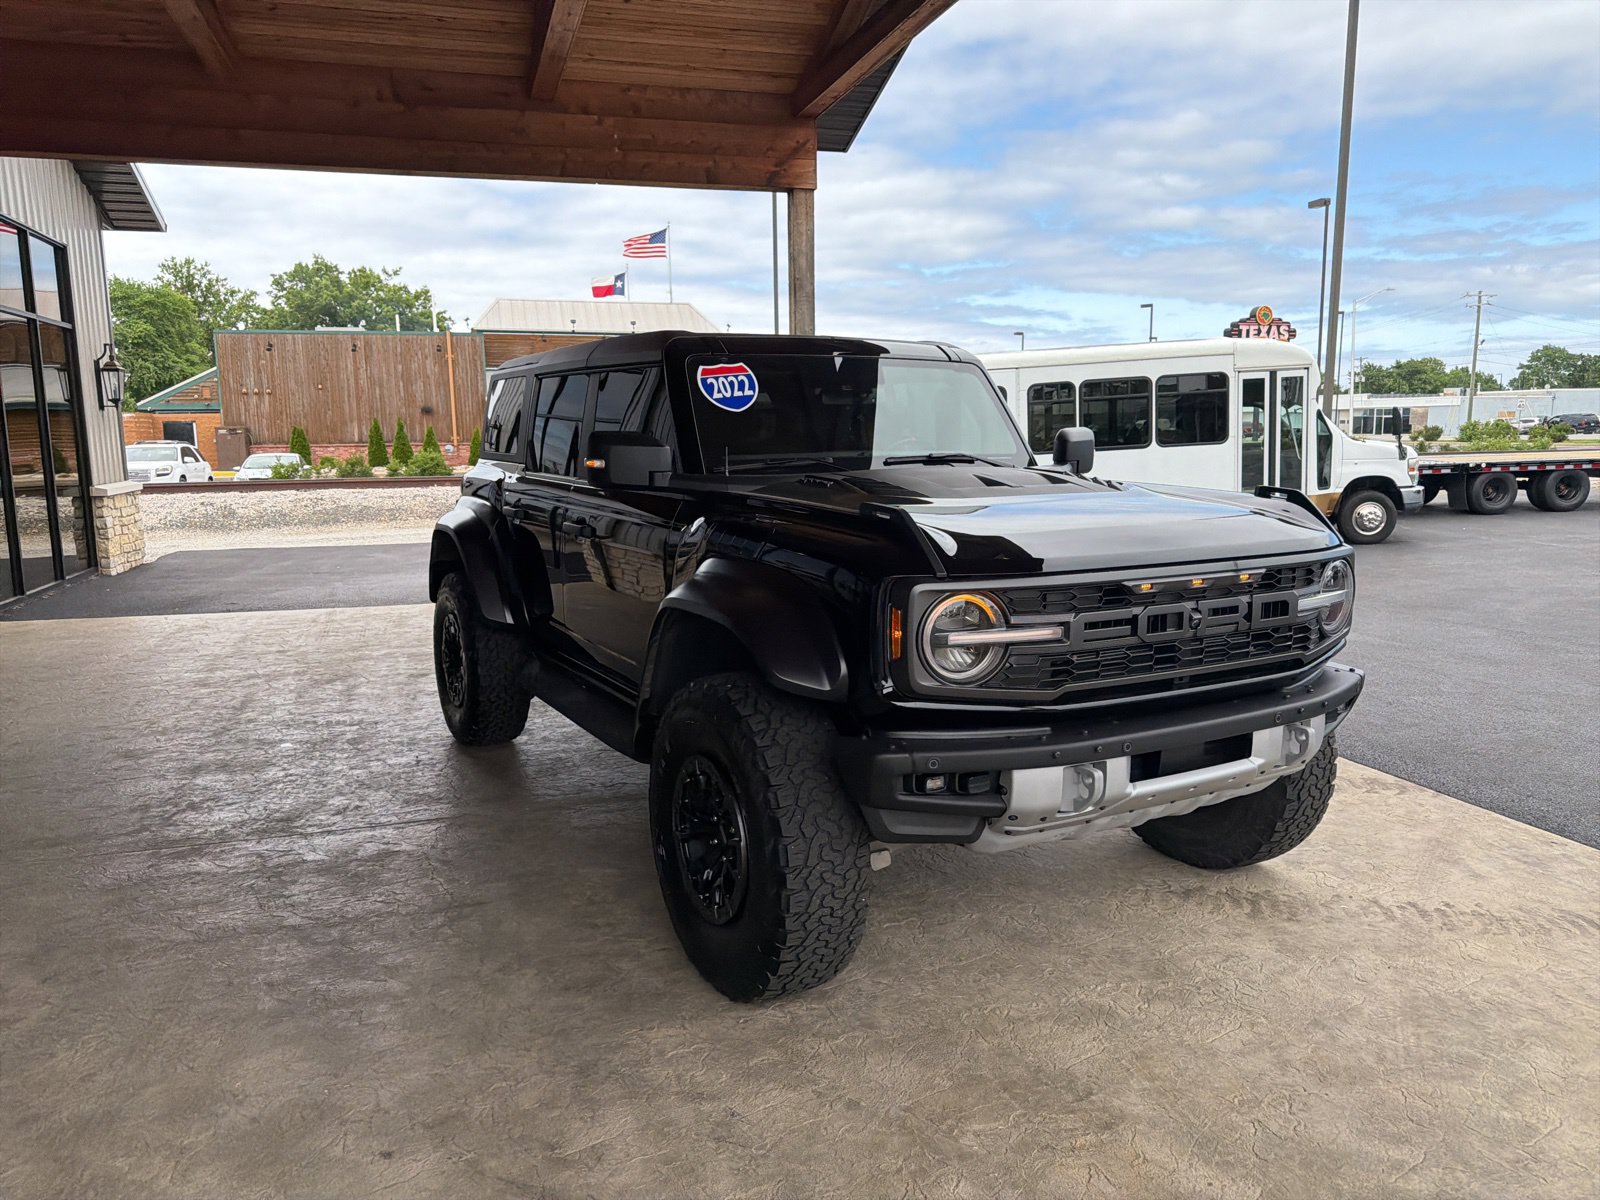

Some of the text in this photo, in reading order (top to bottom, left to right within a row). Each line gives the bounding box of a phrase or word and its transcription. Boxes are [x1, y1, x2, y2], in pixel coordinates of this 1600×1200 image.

[1239, 325, 1289, 341] TEXAS
[707, 375, 754, 399] 2022
[1071, 591, 1299, 650] FORD
